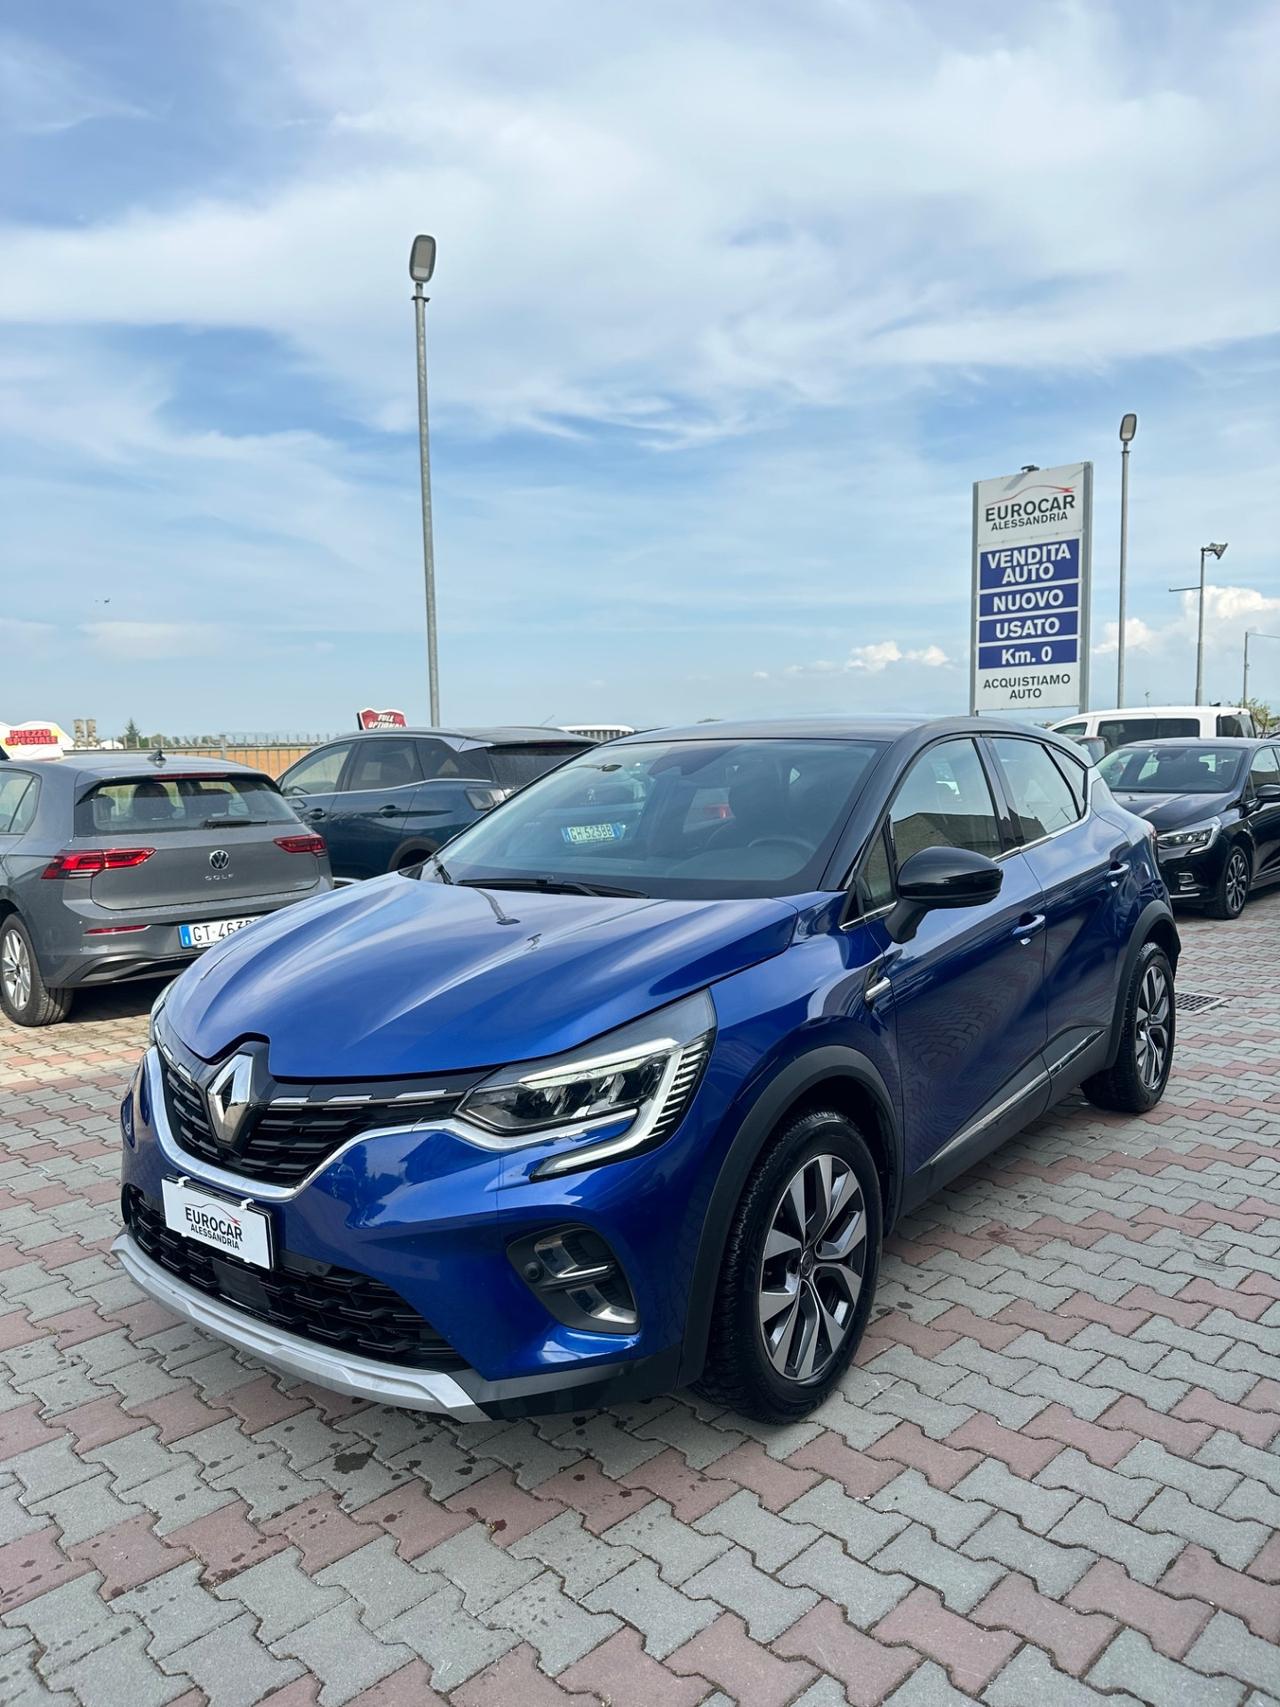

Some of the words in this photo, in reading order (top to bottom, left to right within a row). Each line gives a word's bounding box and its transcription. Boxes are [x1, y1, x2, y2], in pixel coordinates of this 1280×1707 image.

[985, 495, 1075, 522] EUROCAR
[991, 512, 1068, 531] ALESSANDRIA
[987, 543, 1071, 569] VENDITA
[1002, 562, 1054, 584] AUTO
[993, 589, 1064, 612] NUOVO
[996, 617, 1060, 638] USATO
[1001, 648, 1036, 665] Km.
[1041, 646, 1052, 662] 0
[983, 673, 1071, 689] ACQUISTIAMO
[1009, 688, 1042, 700] AUTO
[5, 736, 58, 745] SPECIALE
[10, 729, 51, 737] PREZZO
[185, 1206, 243, 1242] EUROCAR
[190, 1223, 240, 1250] ALESSANDRIA
